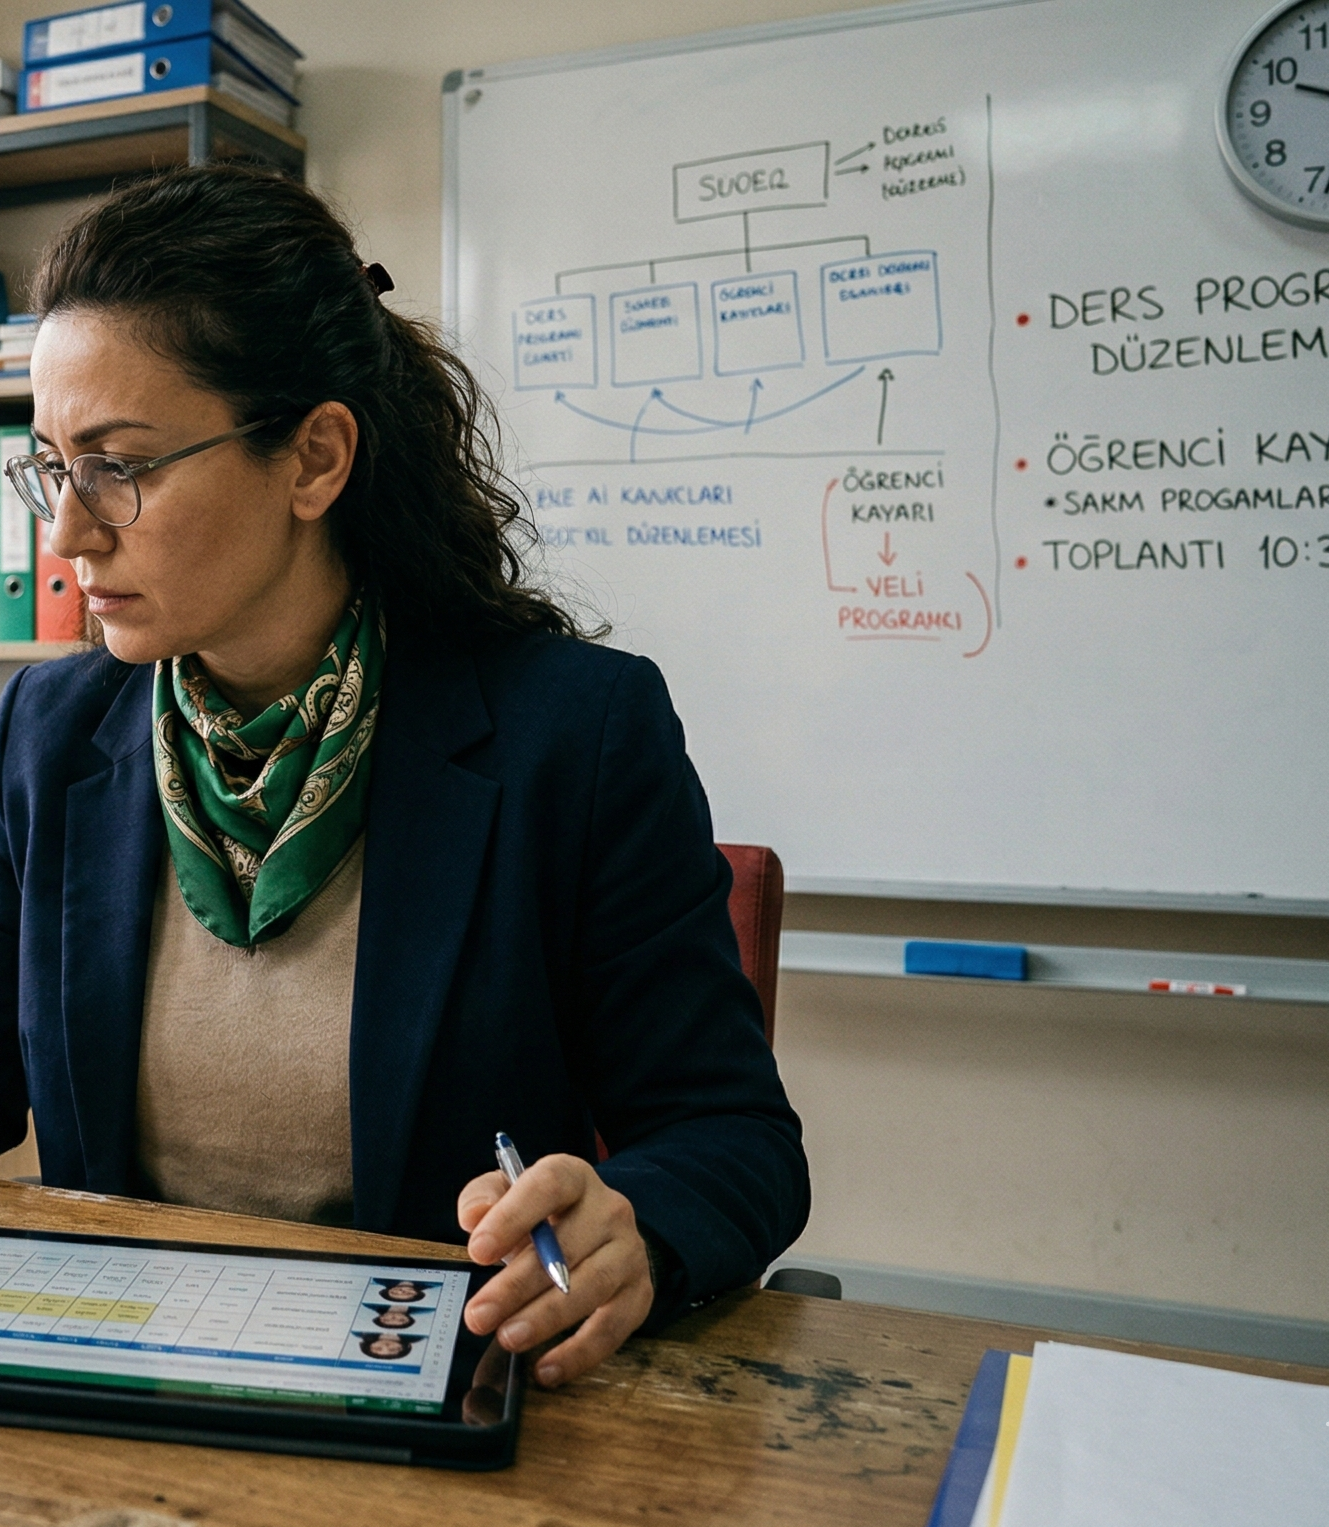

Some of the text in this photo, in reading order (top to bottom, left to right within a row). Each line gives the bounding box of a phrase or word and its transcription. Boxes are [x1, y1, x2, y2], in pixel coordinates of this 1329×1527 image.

[1298, 22, 1327, 51] 11
[1262, 57, 1298, 86] 10
[1249, 99, 1272, 127] 9
[1264, 139, 1287, 166] 8
[1303, 165, 1326, 193] 7
[1049, 285, 1164, 330] DERS
[1091, 326, 1328, 376] DÜZENLEM
[1047, 427, 1329, 476] ÖĞRENCİ KAY
[843, 460, 944, 493] ÖĞRENCİ
[852, 502, 934, 524] KAYARI
[1042, 539, 1225, 571] TOPLANTI
[866, 570, 924, 598] VELİ
